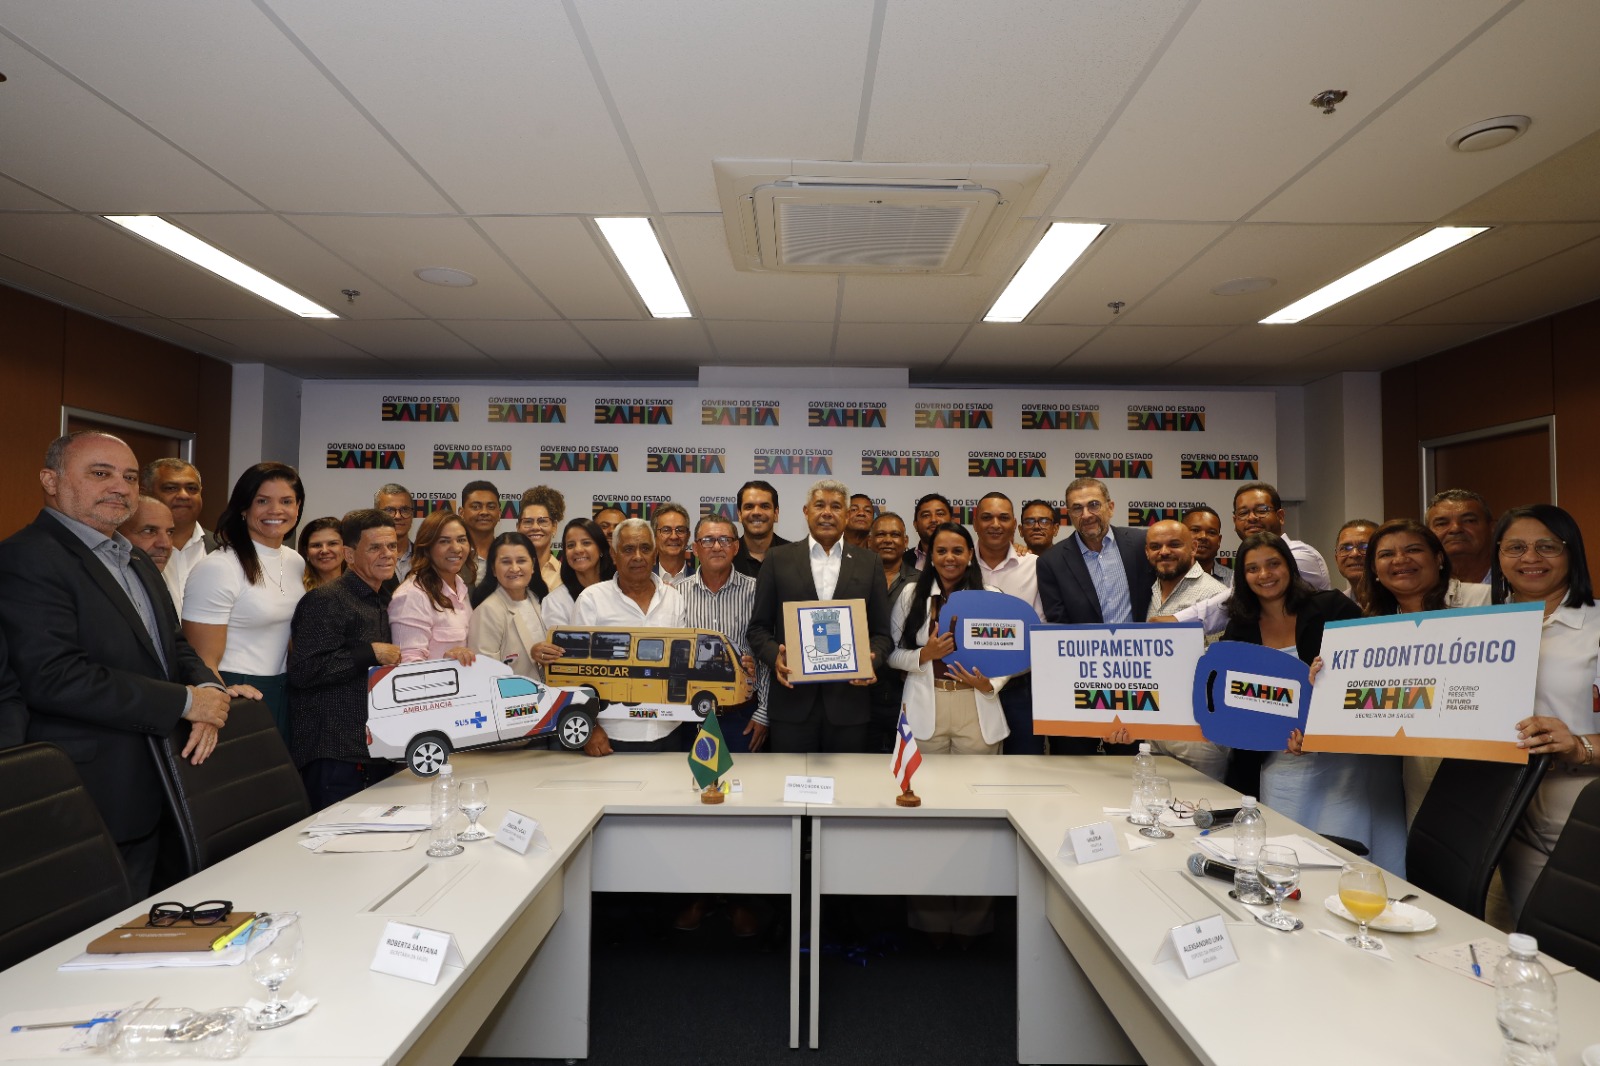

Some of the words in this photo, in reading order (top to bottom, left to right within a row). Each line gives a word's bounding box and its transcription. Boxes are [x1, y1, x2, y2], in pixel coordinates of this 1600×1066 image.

[1058, 639, 1174, 657] EQUIPAMENTOS
[1332, 649, 1359, 670] KIT
[1364, 638, 1516, 668] ODONTOLÓGICO
[579, 665, 629, 677] ESCOLAR
[813, 663, 848, 671] AIQUARA
[1080, 661, 1097, 678] DE
[1103, 659, 1152, 679] SAÚDE
[1074, 690, 1159, 711] BAHIA
[1231, 680, 1293, 704] BAHIA
[1343, 687, 1436, 709] BAHIA
[386, 939, 411, 949] ROBERTA
[412, 944, 438, 955] SANTANA
